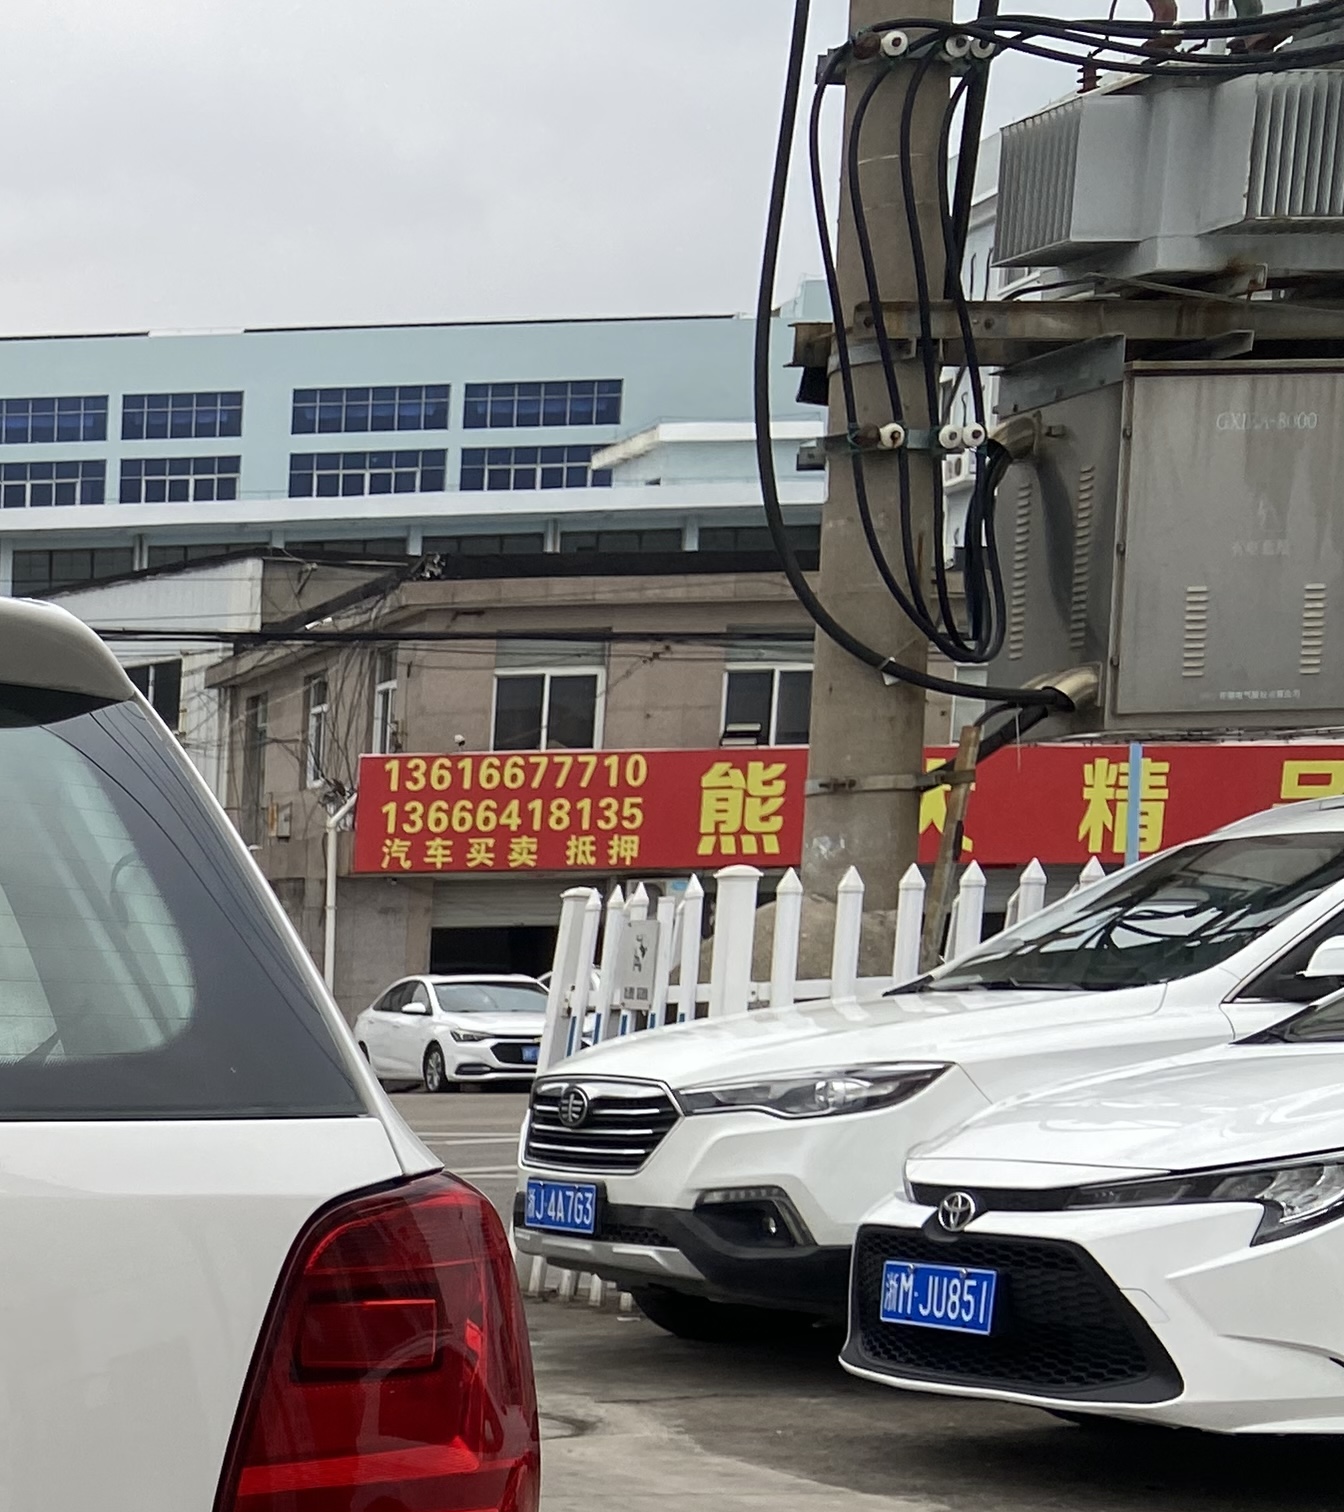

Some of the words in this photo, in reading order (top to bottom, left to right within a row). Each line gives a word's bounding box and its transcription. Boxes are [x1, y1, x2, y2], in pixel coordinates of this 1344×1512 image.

[384, 753, 648, 792] 13616677710
[380, 796, 645, 834] 13666418135
[380, 835, 538, 870] 汽车买卖
[565, 834, 641, 867] 抵押
